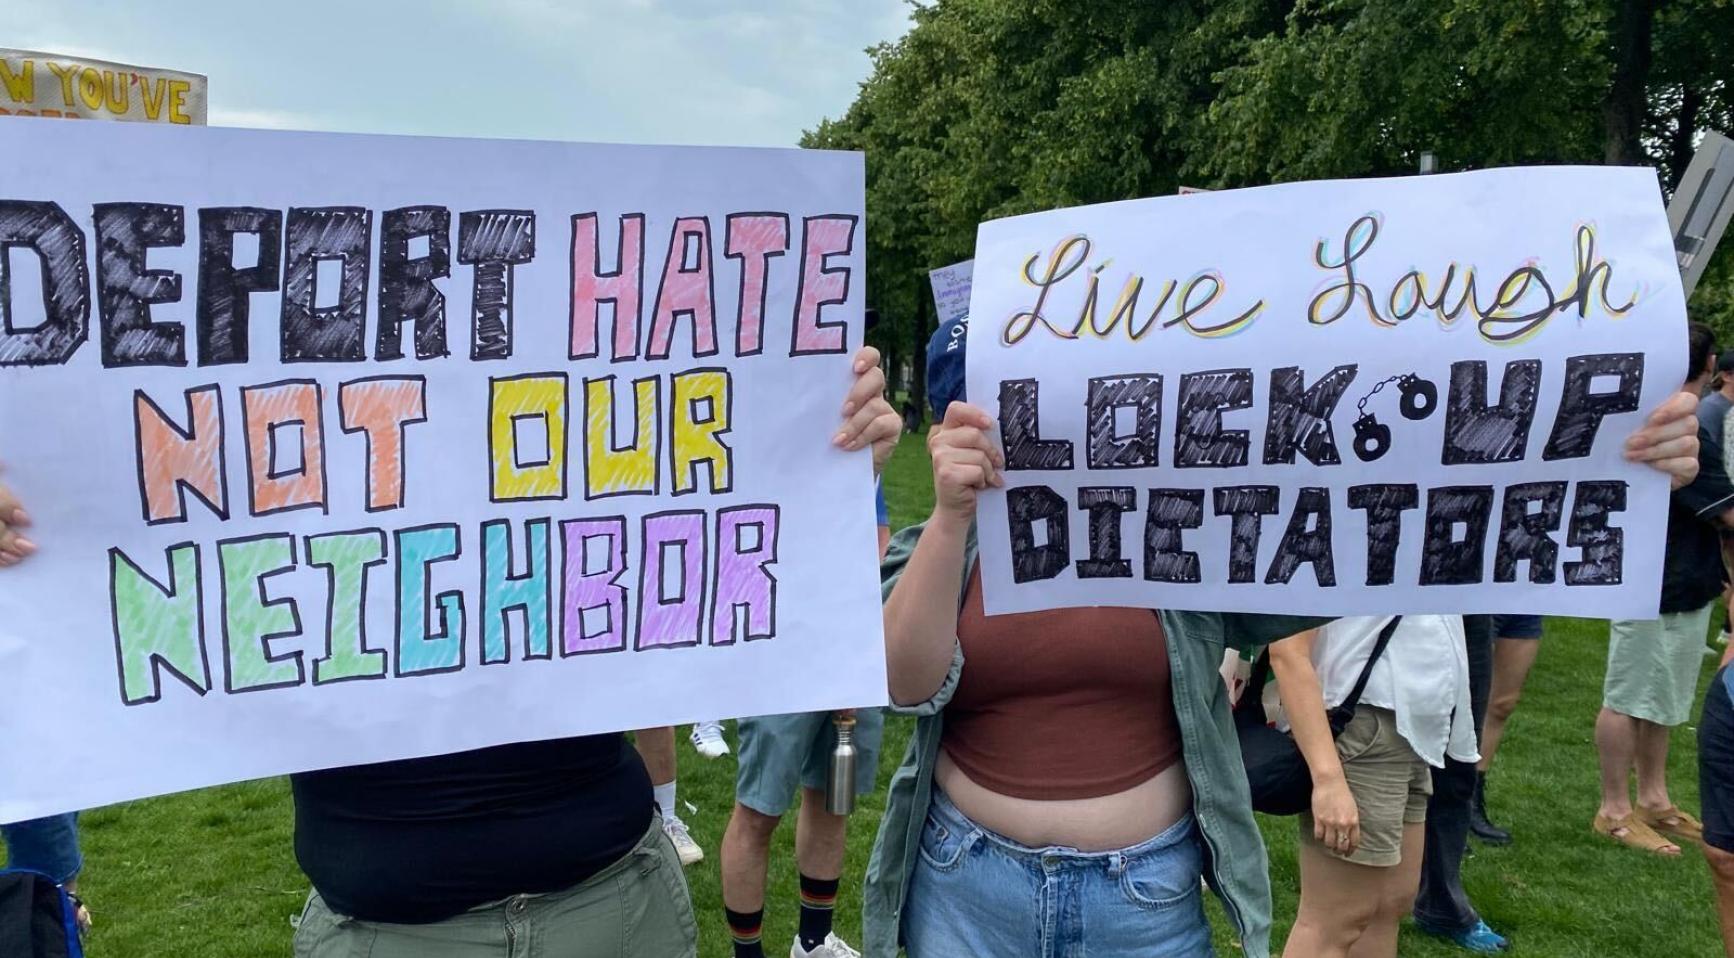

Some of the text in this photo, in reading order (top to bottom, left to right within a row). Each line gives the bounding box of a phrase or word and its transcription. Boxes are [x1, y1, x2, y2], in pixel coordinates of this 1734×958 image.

[46, 61, 191, 125] YOU'VE
[0, 200, 859, 368] DEPORT HATE
[1001, 211, 1636, 346] Live Laugh
[133, 367, 734, 525] NOT OUR
[998, 352, 1646, 470] LOCK UP
[1006, 480, 1631, 587] DICTATORS
[108, 504, 780, 706] NEIGHBOR
